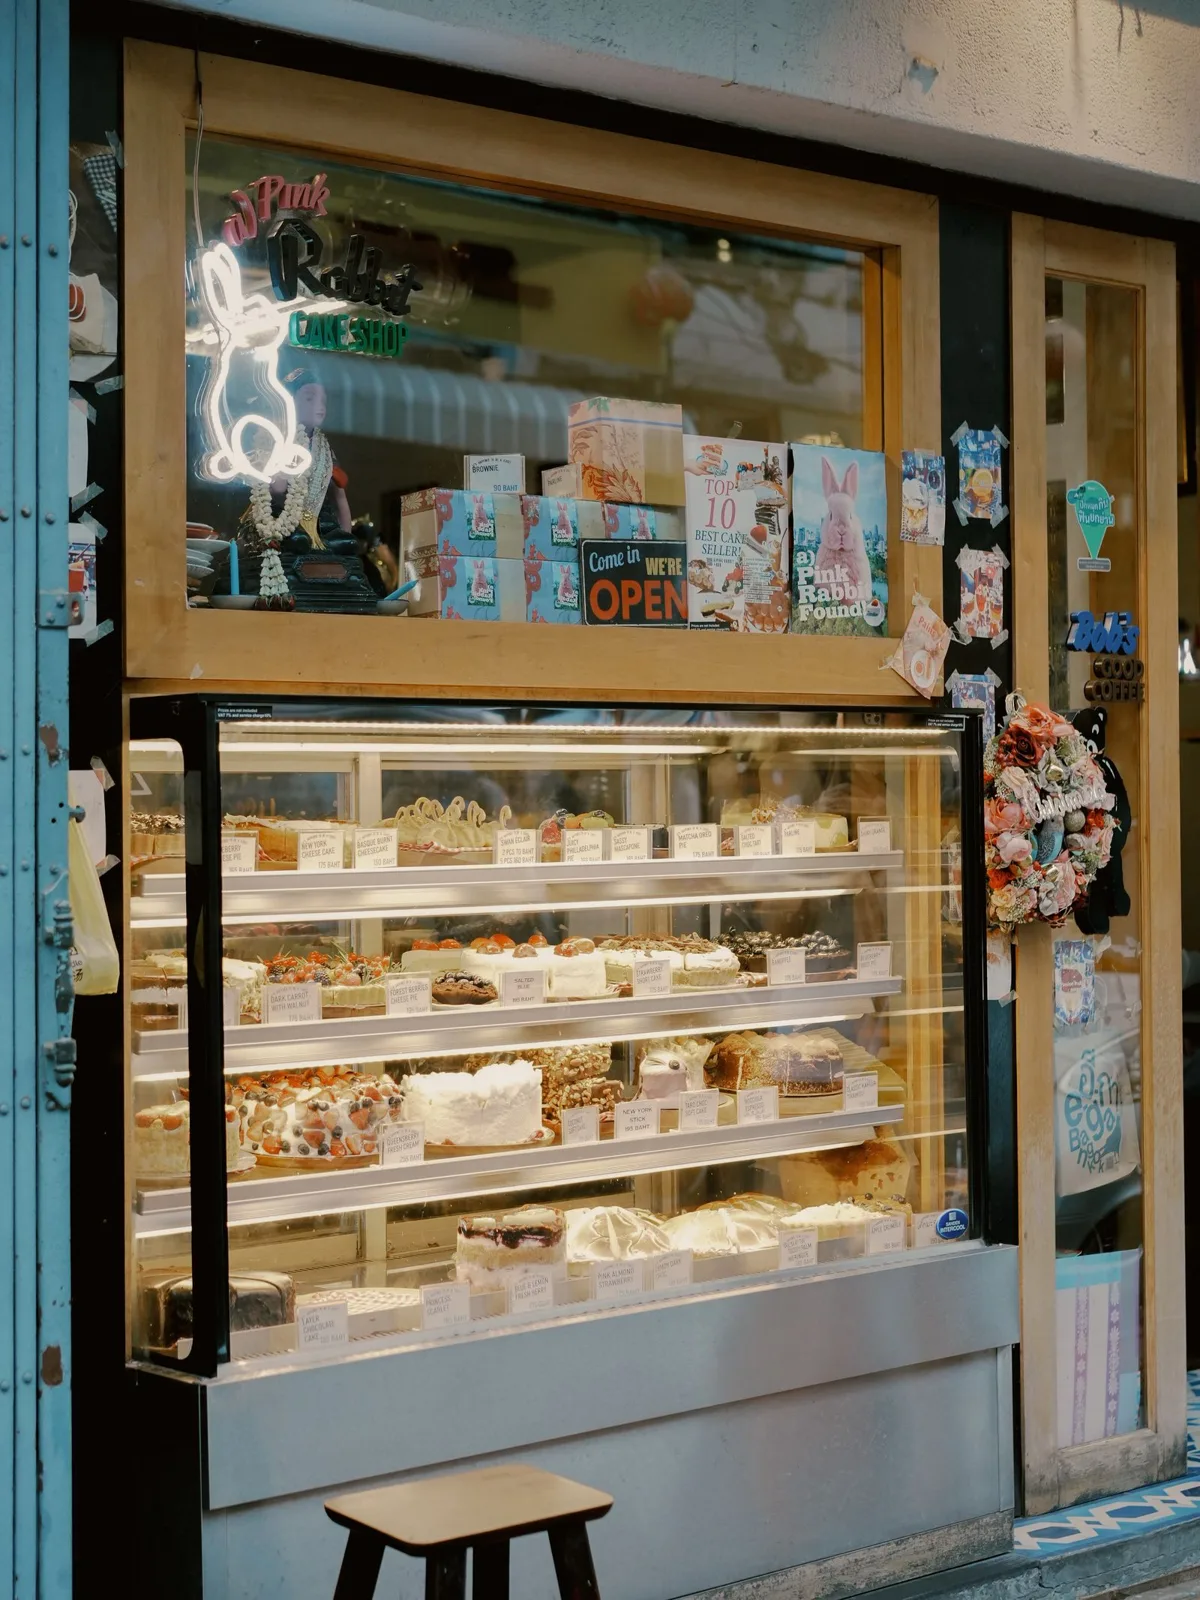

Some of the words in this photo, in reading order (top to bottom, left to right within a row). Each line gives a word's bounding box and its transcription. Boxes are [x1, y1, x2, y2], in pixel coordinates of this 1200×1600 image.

[248, 173, 330, 221] Pink
[289, 311, 350, 349] CAKE
[349, 316, 410, 358] SHOP
[472, 465, 498, 473] BROWNIE
[705, 479, 734, 496] TOP
[705, 497, 736, 530] 10
[695, 530, 719, 542] BEST
[721, 531, 747, 544] CAKE
[702, 544, 741, 557] SELLER!
[589, 552, 624, 572] Come
[627, 546, 640, 564] in
[645, 558, 683, 576] WE'RE
[797, 564, 849, 585] Pink
[590, 579, 688, 620] OPEN
[1066, 610, 1140, 655] Bob's
[1094, 657, 1144, 681] GOOD
[1084, 680, 1145, 702] COFFEE
[614, 837, 628, 846] SASSY
[678, 833, 699, 841] MATCHA
[699, 831, 712, 839] OREO
[741, 832, 755, 840] SALTED
[302, 842, 314, 850] NEW
[314, 840, 327, 849] YORK
[357, 838, 377, 849] BASQUE
[378, 836, 393, 845] BURNT
[501, 838, 514, 847] SWAN
[567, 839, 579, 847] JUICY
[234, 853, 242, 861] PIE
[302, 850, 321, 859] CHEESE
[322, 847, 336, 856] CAKE
[357, 845, 388, 857] CHEESECAKE
[383, 858, 395, 866] BAHT
[522, 856, 535, 864] BAHT
[637, 966, 663, 977] STRAWBERRY
[637, 977, 651, 985] SHORT
[651, 974, 662, 982] CAKE
[390, 988, 408, 997] FOREST
[409, 984, 428, 994] BERRIES
[271, 994, 286, 1004] DARK
[287, 992, 309, 1001] CARROT
[391, 997, 409, 1005] CHEESE
[272, 1003, 286, 1012] WITH
[287, 1000, 309, 1010] WALNUT
[387, 1132, 419, 1146] QUEENSBERRY
[388, 1144, 402, 1154] FRESH
[403, 1140, 420, 1151] CREAM
[410, 1154, 421, 1162] BAHT
[940, 1224, 966, 1233] INTERCOOL
[598, 1273, 611, 1282] PINK
[612, 1268, 634, 1278] ALMOND
[532, 1277, 549, 1287] LEMON
[599, 1278, 634, 1289] STRAWBERRY
[515, 1290, 531, 1300] FRESH
[532, 1286, 547, 1296] BERRY
[426, 1296, 451, 1306] PRINCESS
[427, 1305, 448, 1316] SCARLET
[302, 1316, 319, 1326] LAYER
[303, 1321, 334, 1334] CHOCOLATE
[305, 1333, 319, 1343] CAKE
[331, 1334, 346, 1342] BAHT
